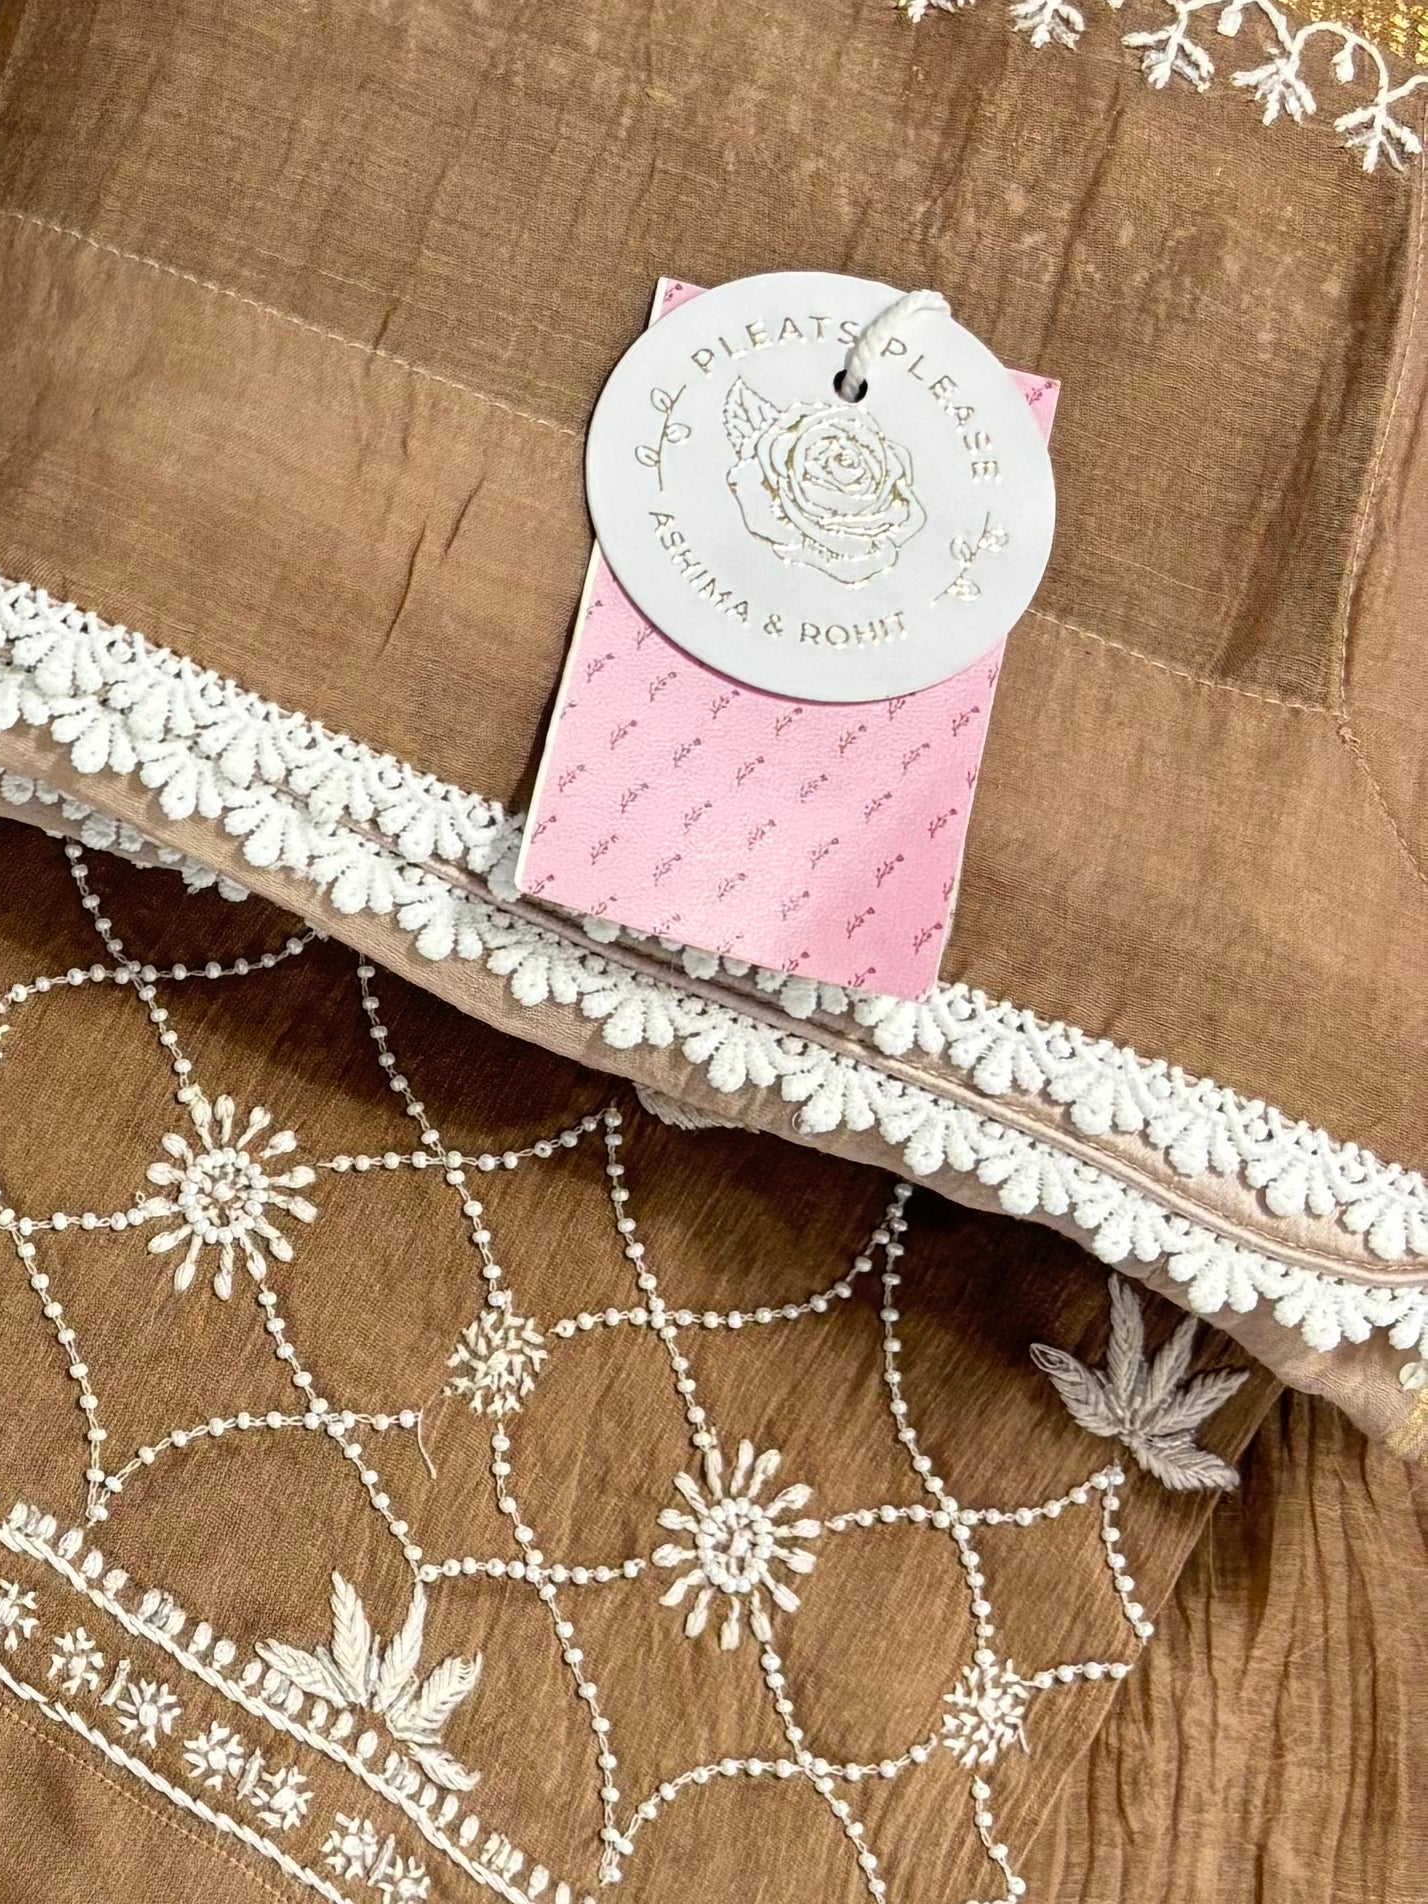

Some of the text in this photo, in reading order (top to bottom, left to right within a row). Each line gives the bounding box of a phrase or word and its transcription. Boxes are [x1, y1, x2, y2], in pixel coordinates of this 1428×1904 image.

[691, 315, 1000, 482] PLEATS PLEASE
[649, 511, 910, 649] ASHIMA & ROHIT
